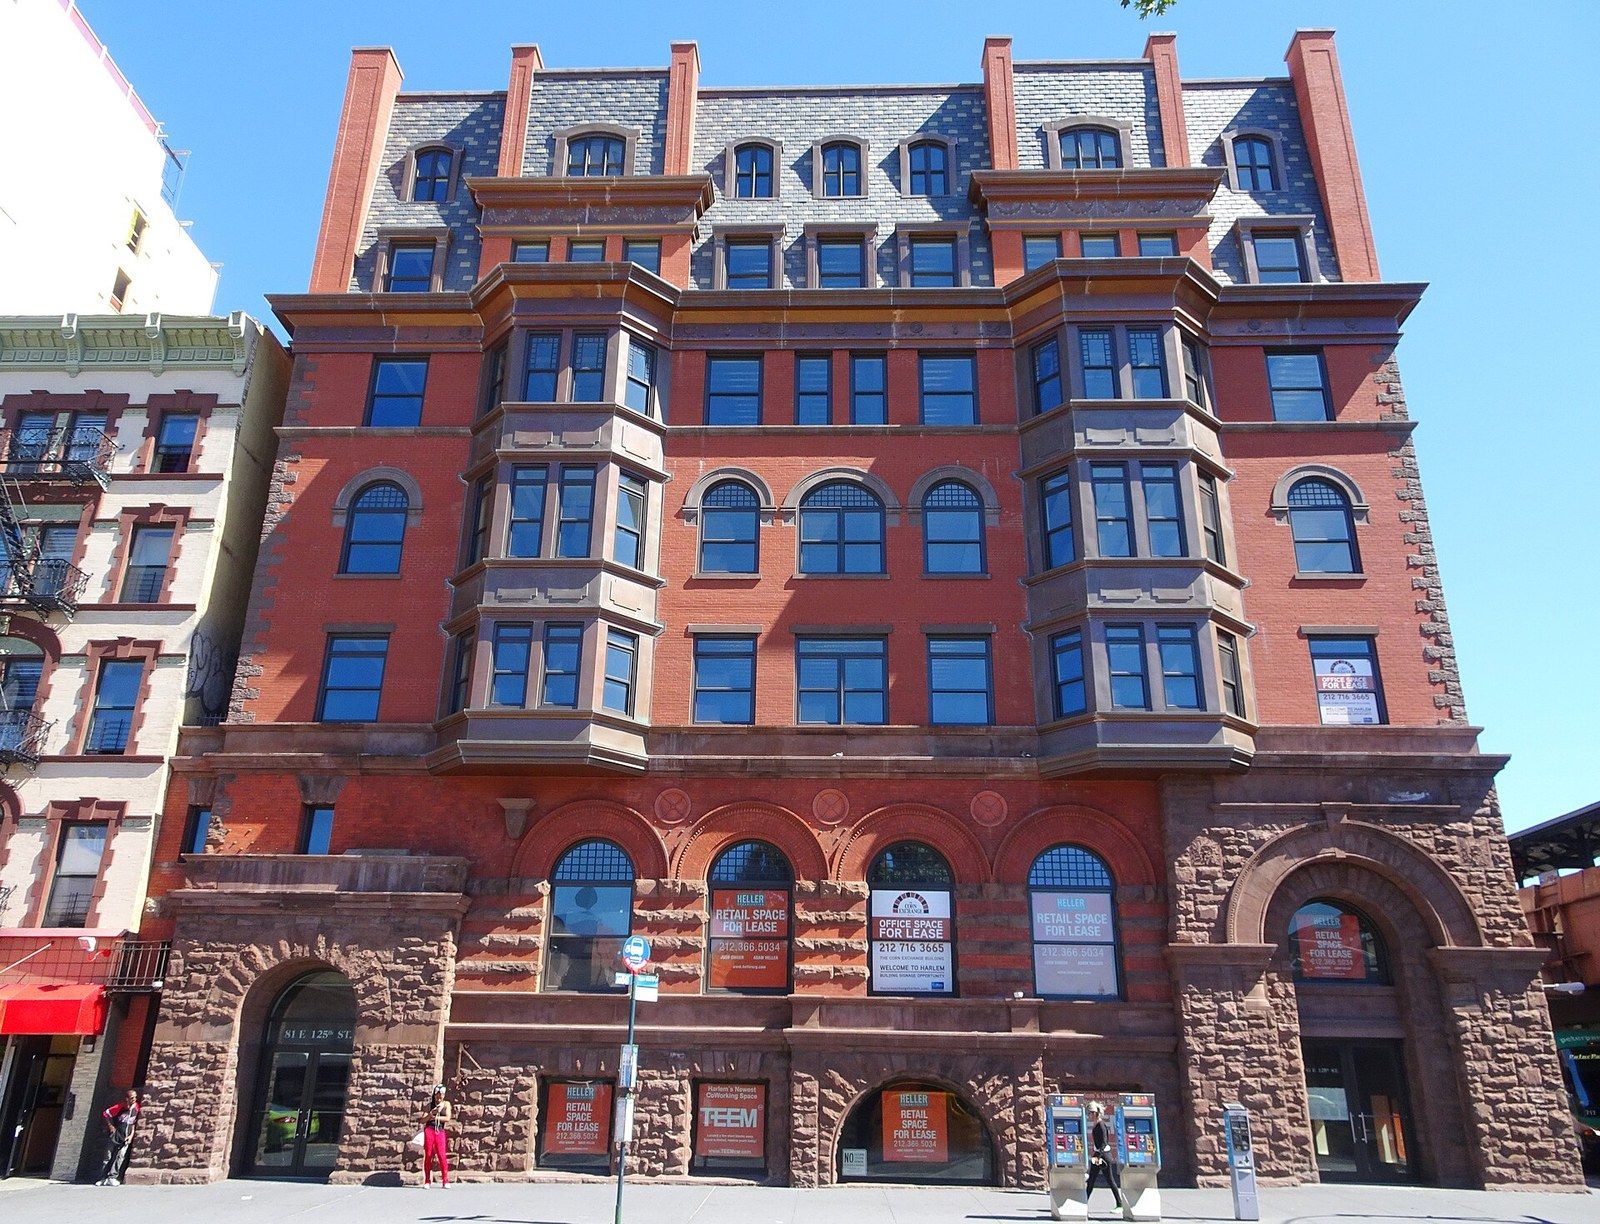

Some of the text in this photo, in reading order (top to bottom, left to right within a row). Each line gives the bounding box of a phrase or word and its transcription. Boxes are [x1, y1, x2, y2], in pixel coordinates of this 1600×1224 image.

[737, 894, 764, 904] HELLER
[1057, 898, 1085, 907] HELLER
[716, 910, 785, 920] RETAIL SPACE
[1037, 913, 1108, 924] RETAIL SPACE
[723, 922, 777, 932] FOR LEASE
[880, 920, 943, 928] OFFICE SPACE
[880, 929, 943, 938] FOR LEASE
[1045, 926, 1101, 937] FOR LEASE
[1315, 931, 1342, 940] RETAIL
[719, 942, 780, 951] 212.366.5034
[880, 943, 944, 953] 212 716 3665
[1317, 941, 1342, 949] SPACE
[1042, 947, 1104, 957] 212.366.5034
[1310, 949, 1352, 958] FOR LEASE
[299, 1030, 306, 1038] E
[567, 1087, 594, 1097] HELLER
[900, 1094, 928, 1103] HELLER
[566, 1102, 593, 1111] RETAIL
[566, 1112, 592, 1121] SPACE
[700, 1107, 758, 1128] TEEM
[901, 1110, 928, 1119] RETAIL
[557, 1122, 599, 1131] FOR LEASE
[902, 1120, 928, 1129] SPACE
[893, 1130, 936, 1139] FOR LEASE
[844, 1153, 853, 1163] NO
